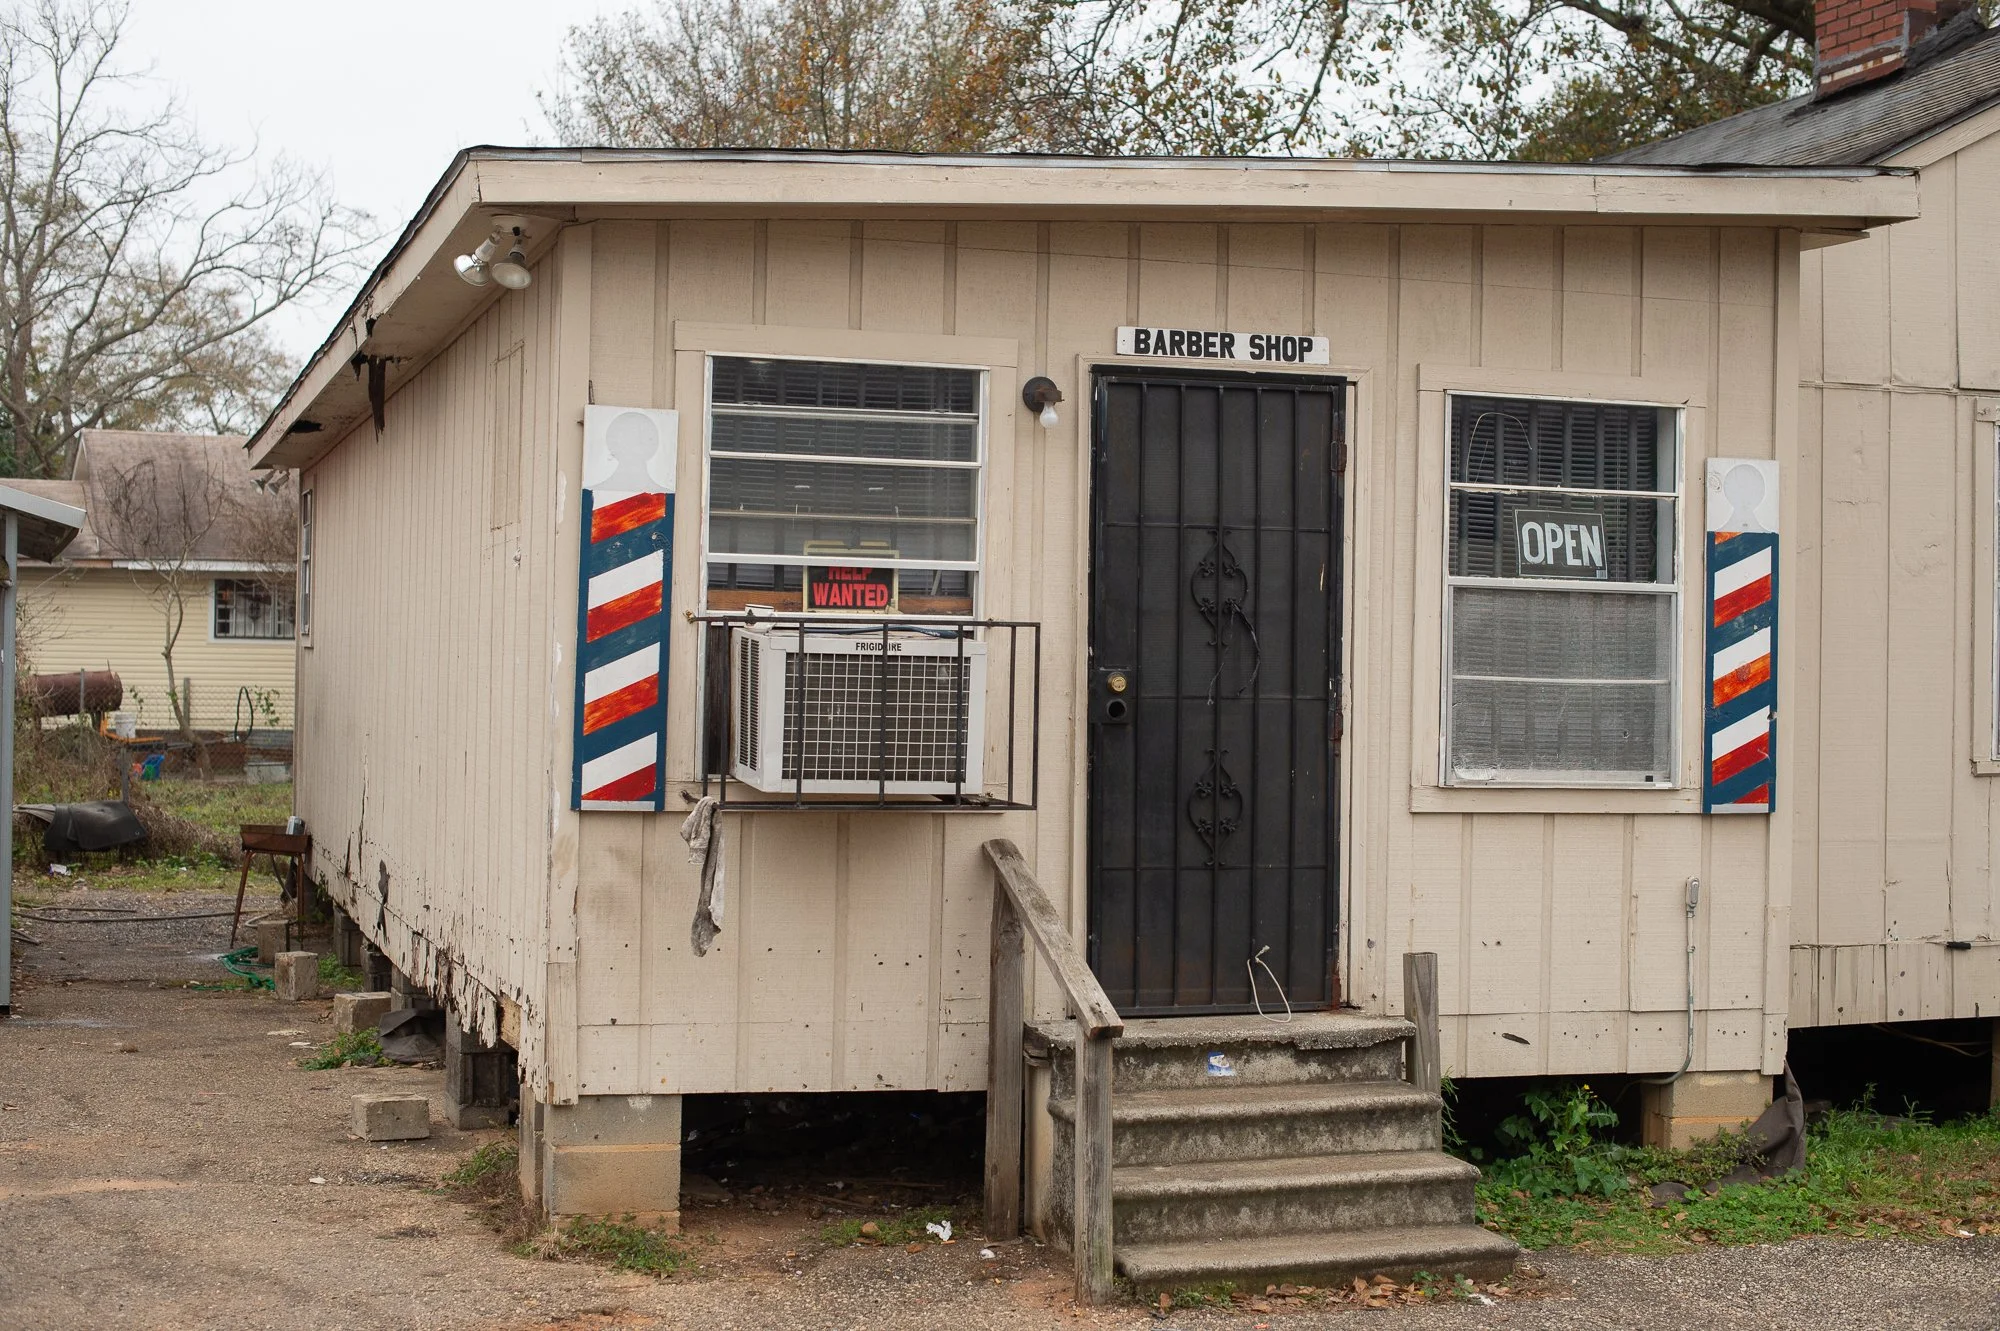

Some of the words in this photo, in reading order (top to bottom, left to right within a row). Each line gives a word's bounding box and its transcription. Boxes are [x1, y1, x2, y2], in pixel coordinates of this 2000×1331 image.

[1134, 328, 1235, 359] BARBER
[1249, 334, 1313, 363] SHOP
[1522, 521, 1603, 567] OPEN
[828, 566, 873, 580] HELP
[813, 582, 888, 607] WANTED
[855, 642, 902, 651] FRIGIDIRE
